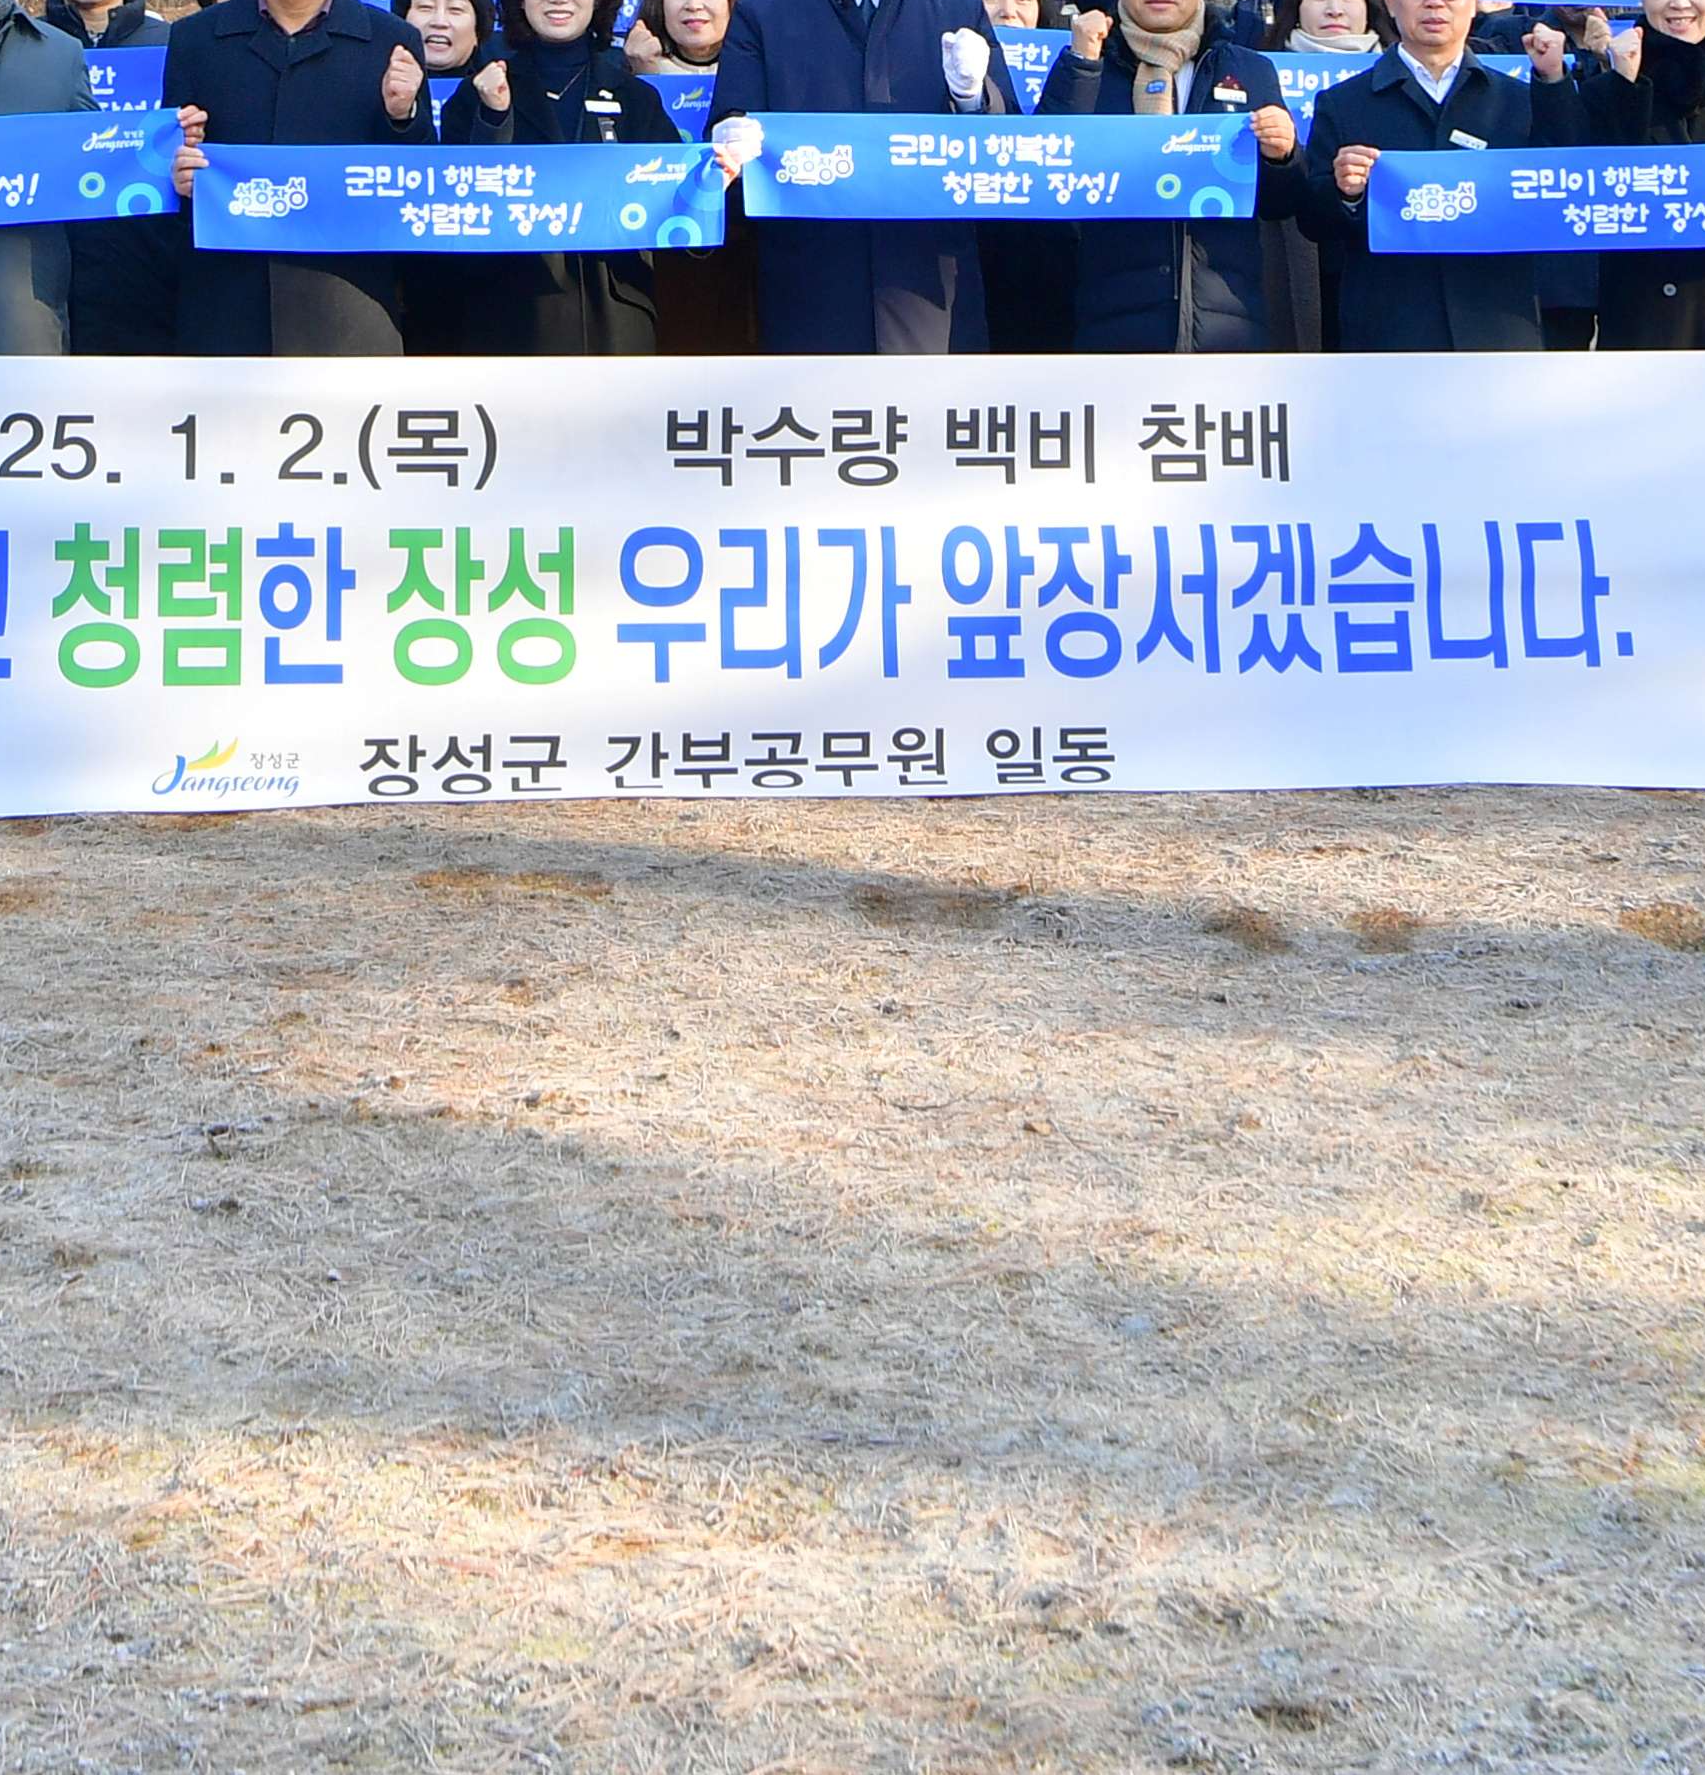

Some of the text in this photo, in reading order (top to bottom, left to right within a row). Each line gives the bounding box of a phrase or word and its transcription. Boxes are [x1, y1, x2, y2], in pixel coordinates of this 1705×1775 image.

[889, 132, 1074, 167] 군민이 행복한
[345, 163, 535, 199] 군민이 행복한
[942, 171, 1120, 205] 청렴한 장성!
[1510, 164, 1689, 200] 군민이 행복한
[399, 202, 583, 236] 청렴한 장성!
[1562, 202, 1649, 235] 청렴한
[171, 414, 234, 485] 1.
[277, 405, 498, 491] 2.(목)
[665, 405, 909, 485] 박수량
[945, 403, 1097, 485] 백비
[1138, 401, 1291, 483] 참배
[52, 522, 355, 689] 청렴한
[386, 524, 577, 686] 장성
[617, 525, 911, 682] 우리가
[941, 518, 1635, 680] 앞장서겠습니다.
[152, 755, 299, 799] Jangseong
[250, 752, 300, 769] 장성군
[359, 724, 1116, 797] 장성군 간부공무원 일동
